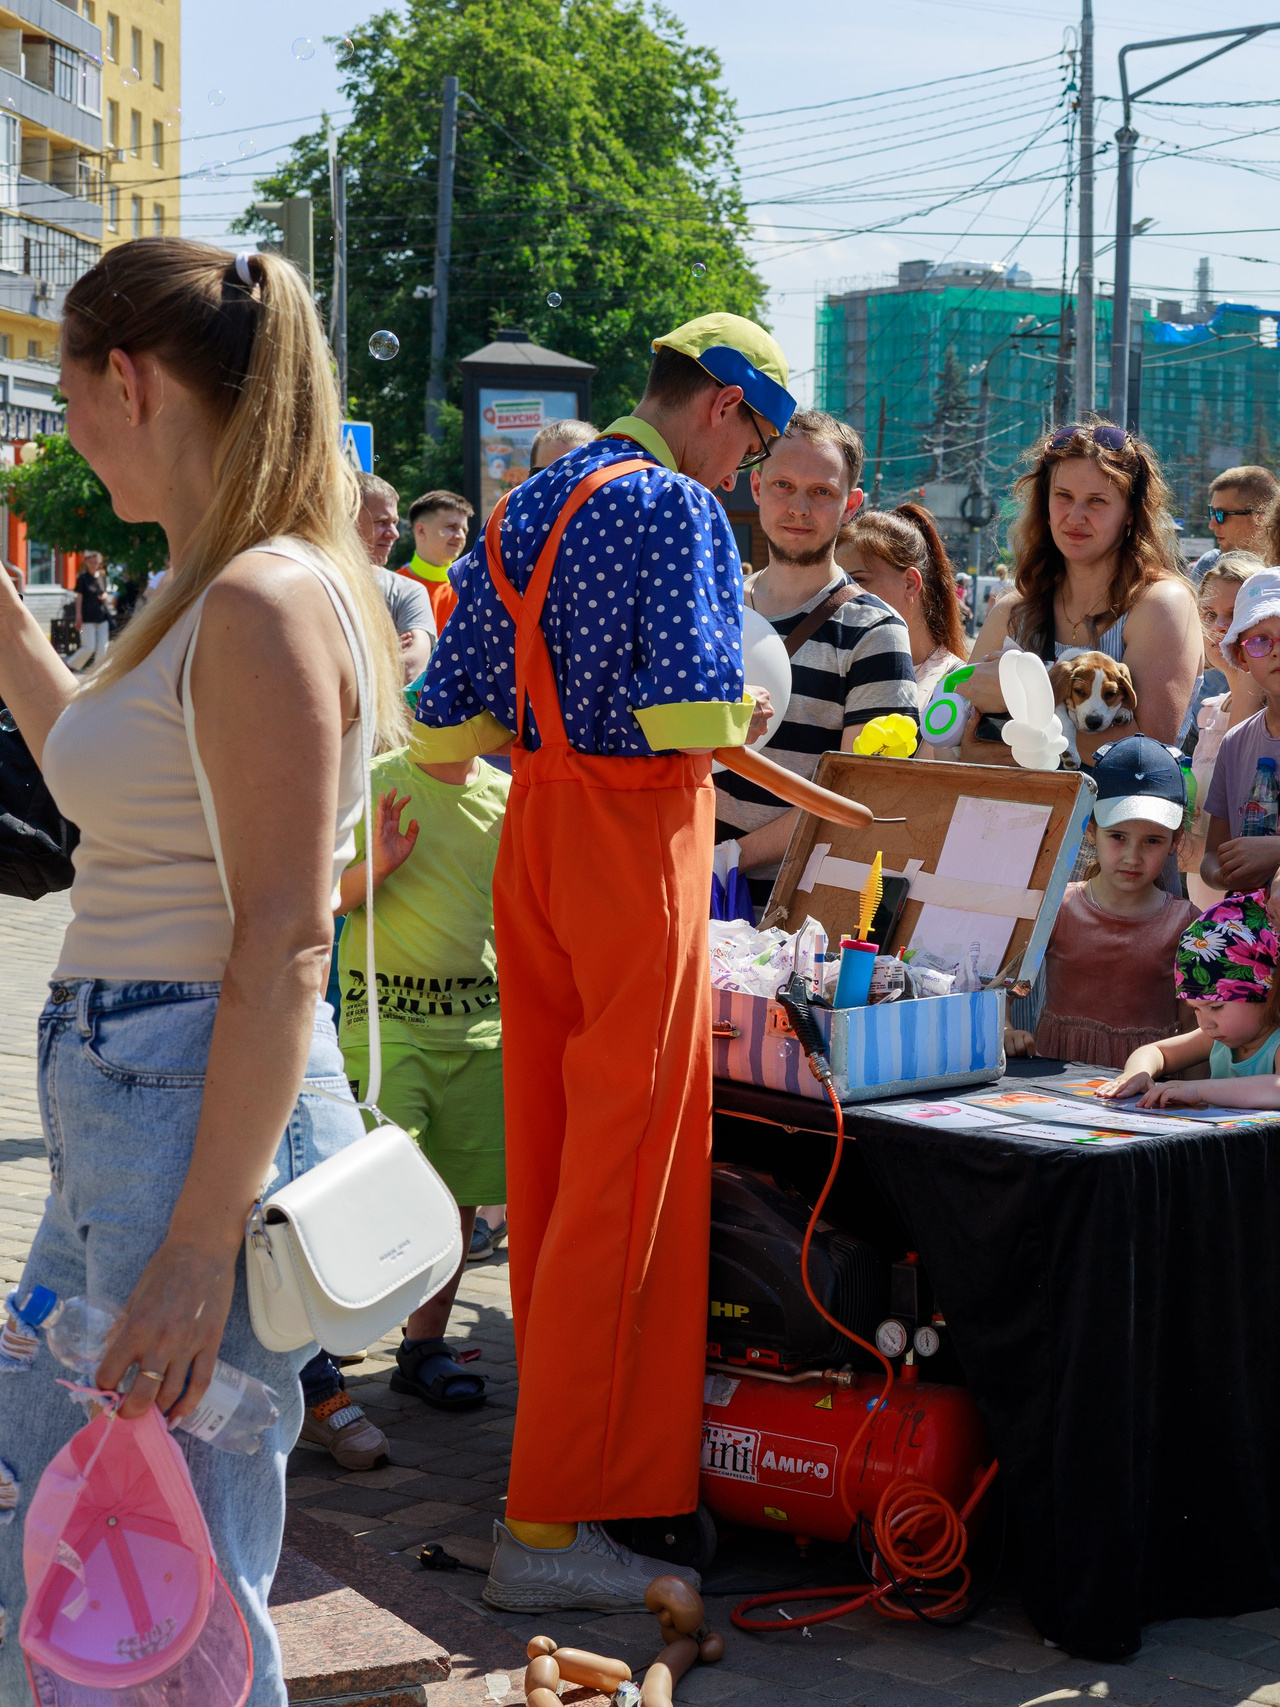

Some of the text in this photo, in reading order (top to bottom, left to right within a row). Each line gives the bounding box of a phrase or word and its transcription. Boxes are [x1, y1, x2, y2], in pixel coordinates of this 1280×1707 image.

[498, 413, 541, 424] ВКУСНО
[711, 1301, 750, 1318] HP
[717, 1469, 756, 1482] COMPRESSORS
